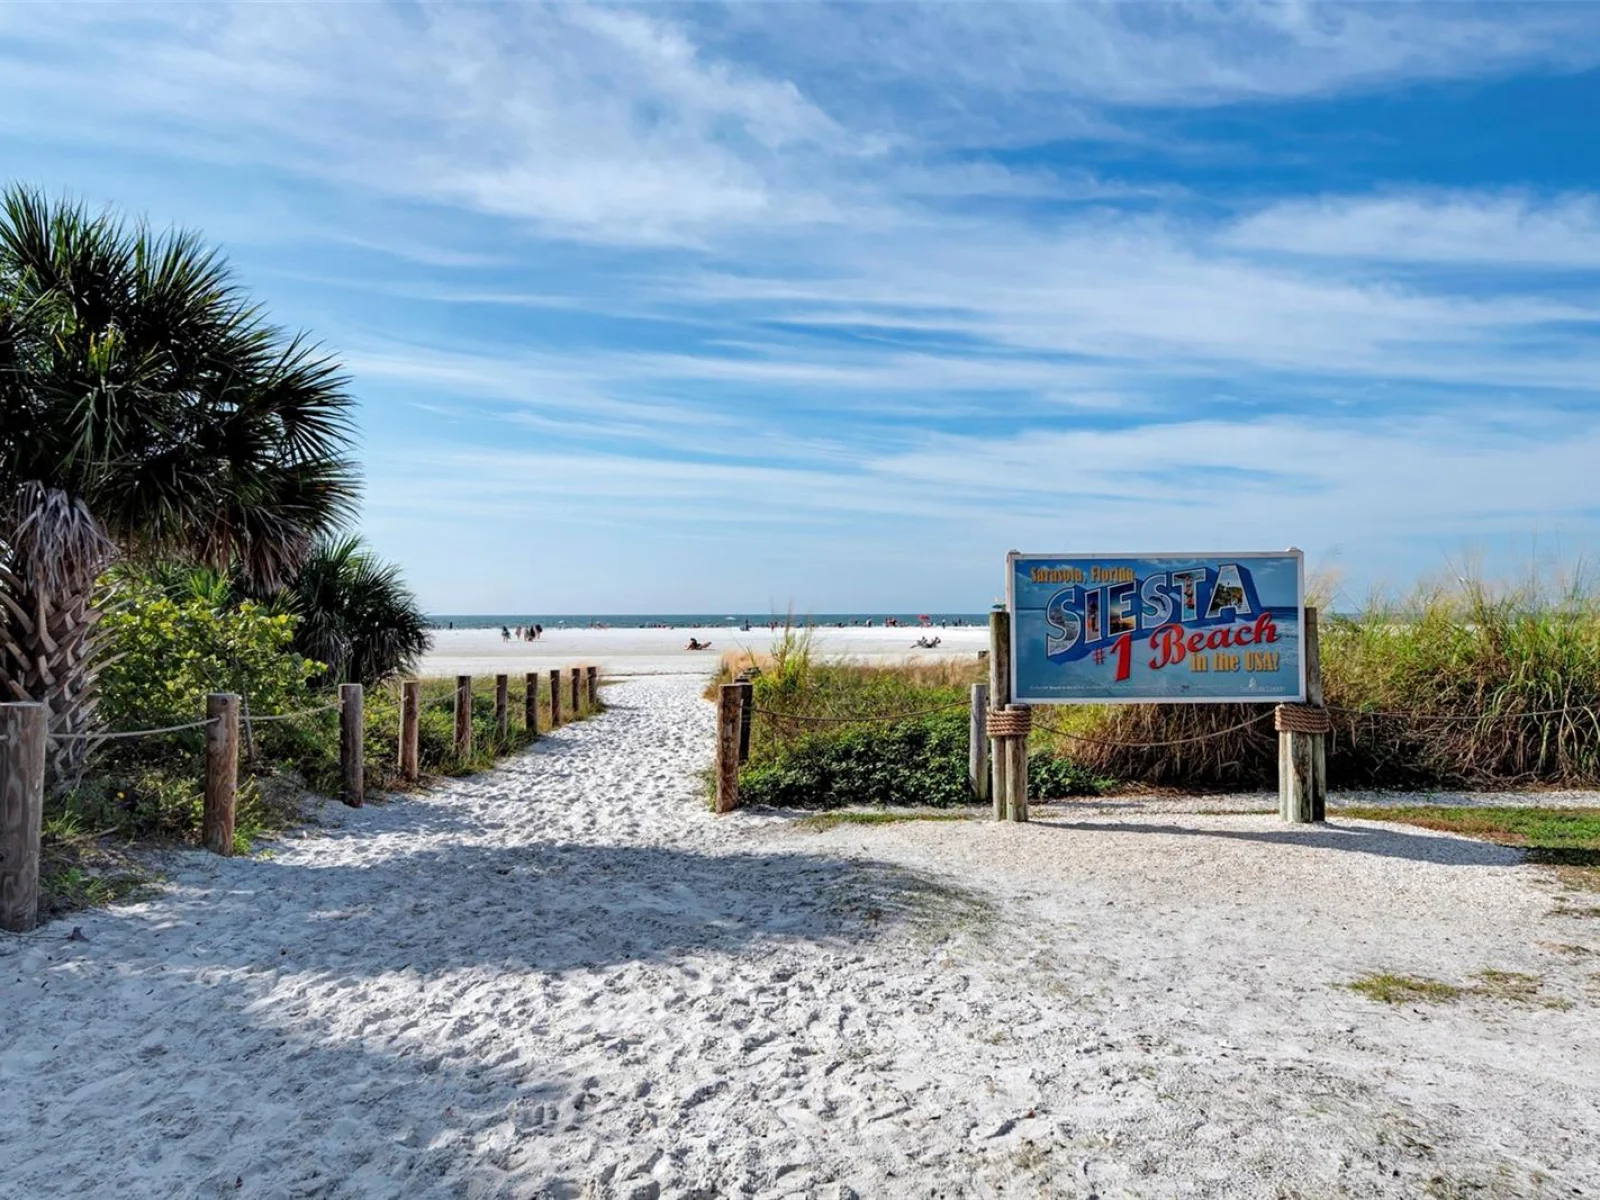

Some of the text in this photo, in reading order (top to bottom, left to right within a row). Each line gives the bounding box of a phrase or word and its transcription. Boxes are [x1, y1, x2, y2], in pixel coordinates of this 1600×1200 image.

[1030, 565, 1135, 585] Sarasota, Florida
[1046, 564, 1255, 660] SIESTA
[1093, 612, 1281, 682] #1 Beach
[1190, 652, 1280, 672] in the USA!
